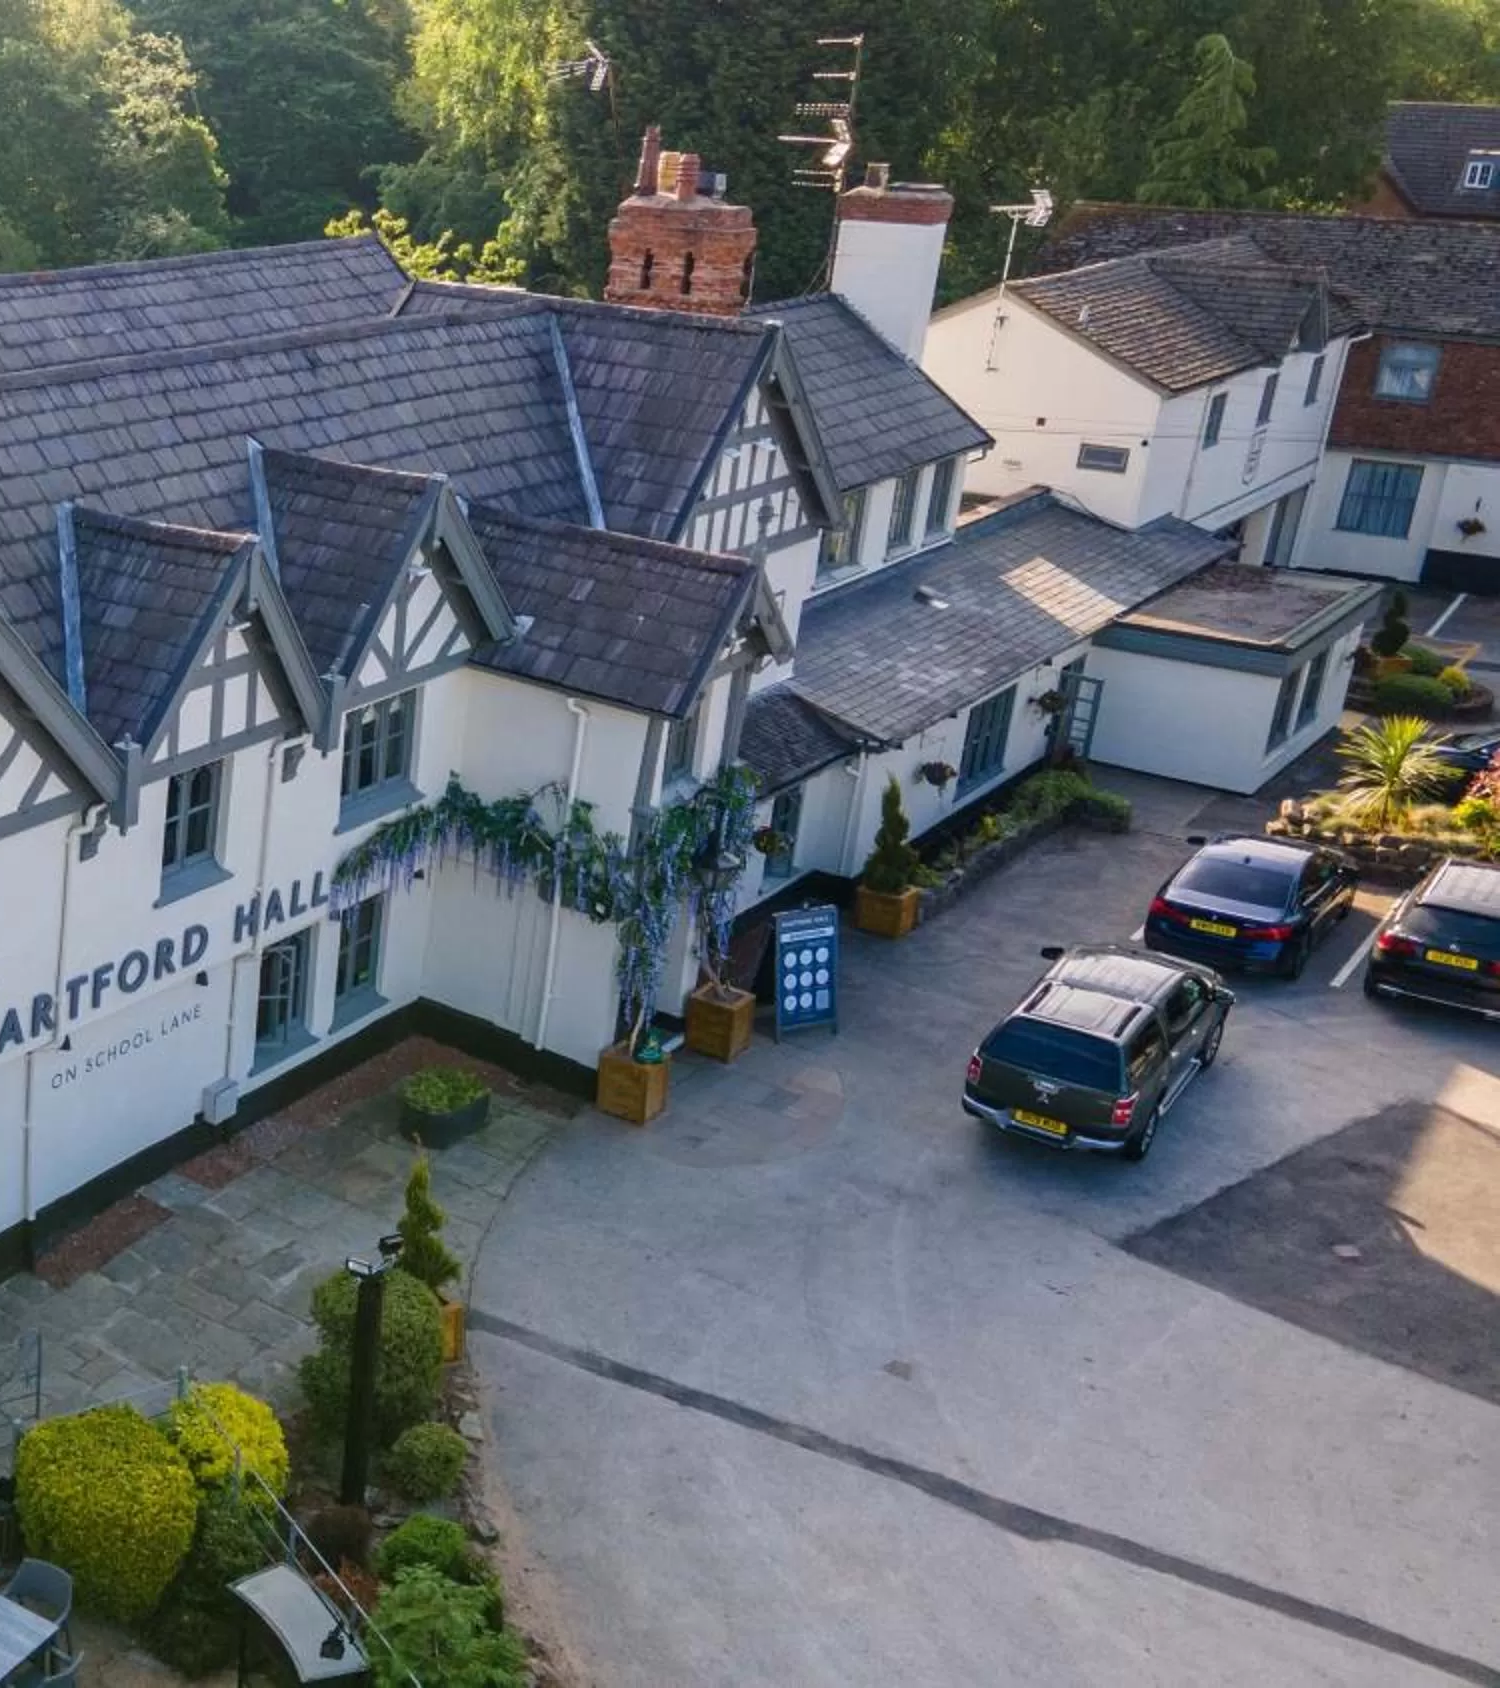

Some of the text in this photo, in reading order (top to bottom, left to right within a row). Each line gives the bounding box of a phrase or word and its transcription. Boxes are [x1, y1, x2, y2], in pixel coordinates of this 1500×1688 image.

[233, 869, 329, 943] HALL
[51, 1003, 201, 1089] ON SCHOOL LANE
